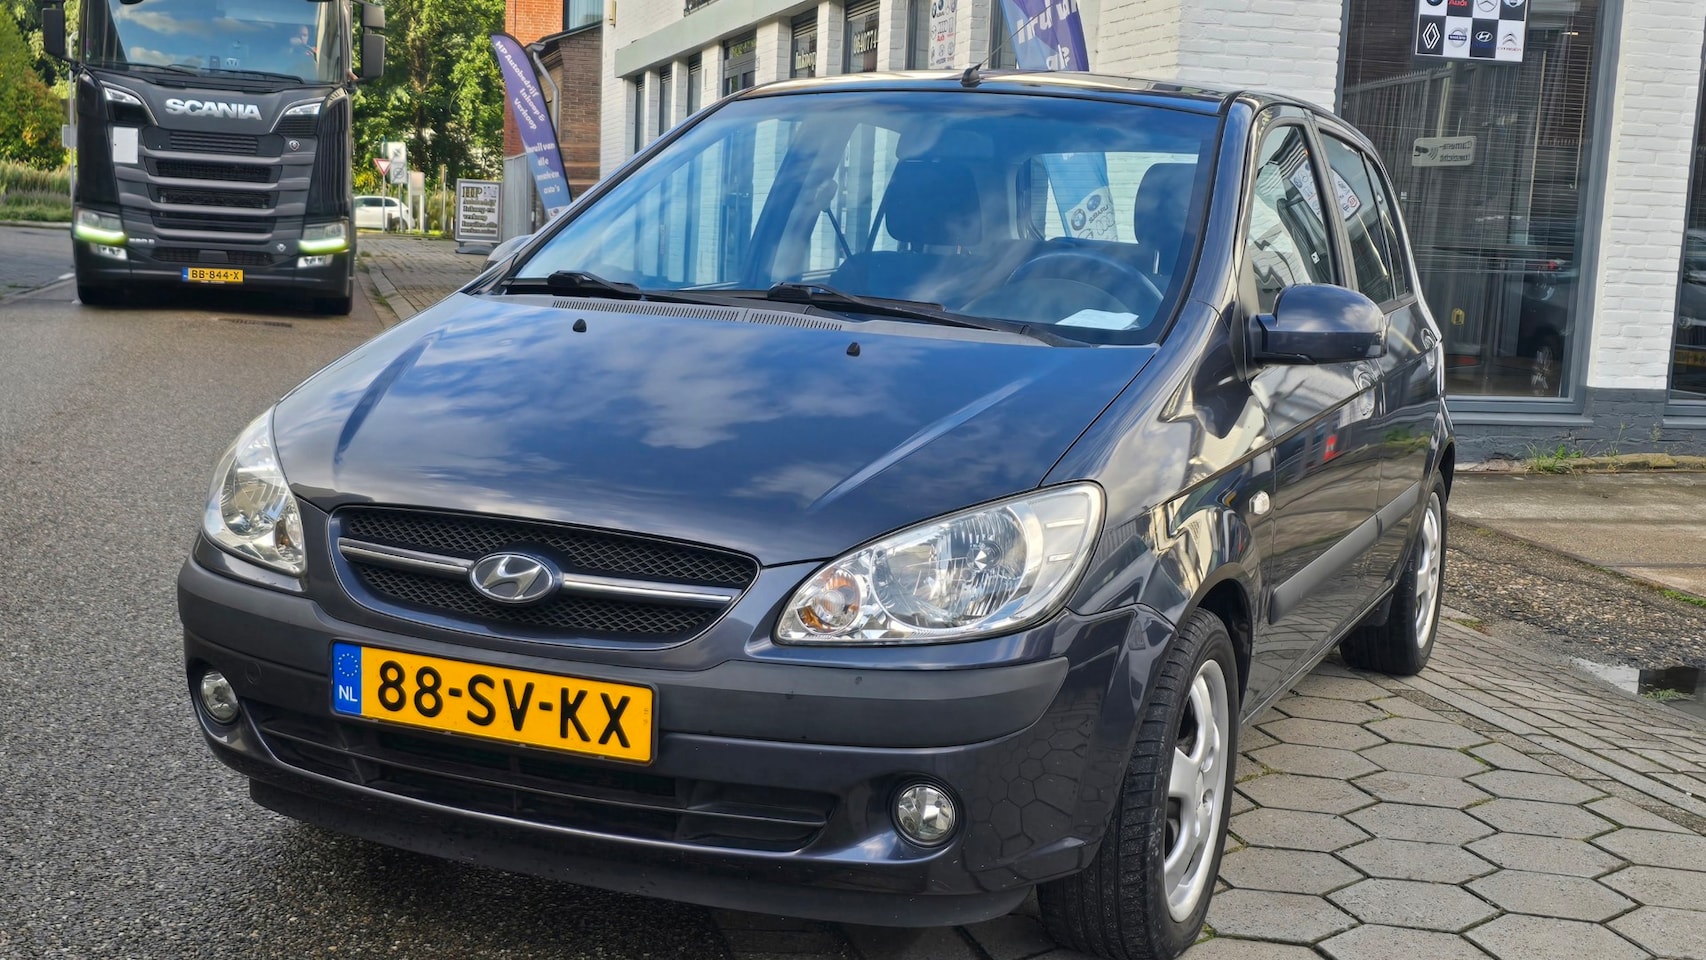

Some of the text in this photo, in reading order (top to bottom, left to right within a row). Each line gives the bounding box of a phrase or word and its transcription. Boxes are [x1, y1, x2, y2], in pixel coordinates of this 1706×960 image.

[495, 40, 540, 98] HP Autobedrijf
[165, 98, 263, 121] SCANIA
[513, 97, 538, 130] Verkoop
[519, 87, 540, 116] Inkoop
[191, 269, 240, 280] BB-844-X
[338, 684, 358, 703] NL
[377, 660, 631, 749] 88-SV-KX
